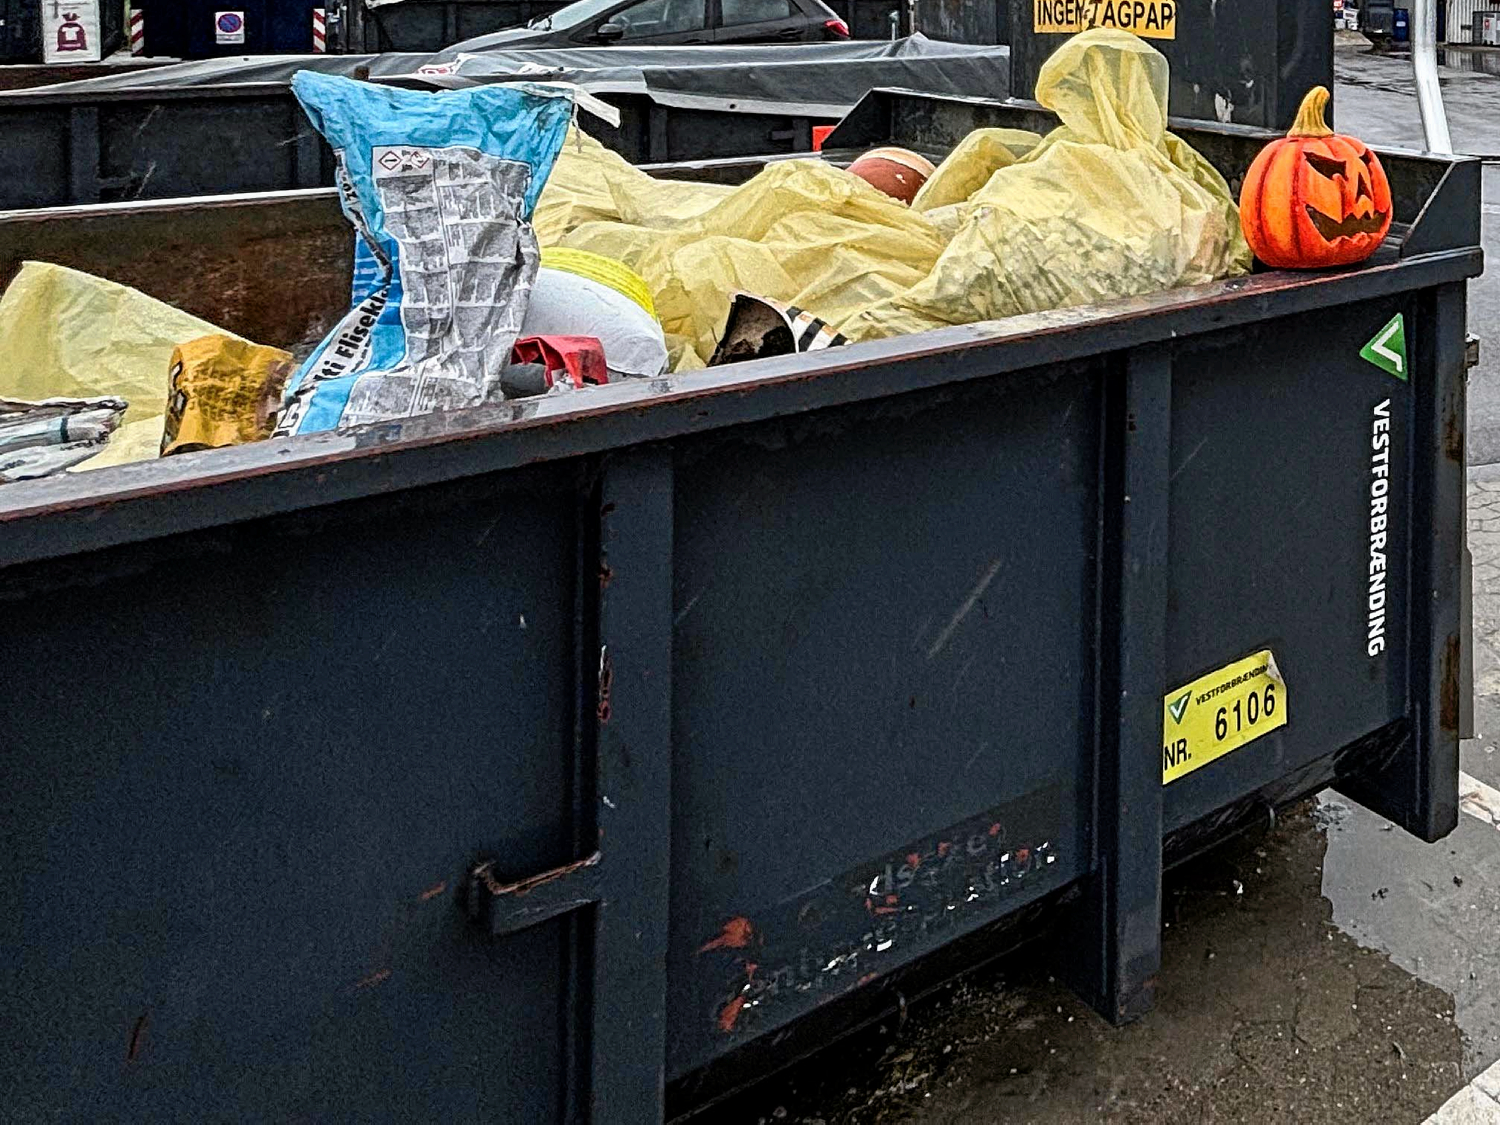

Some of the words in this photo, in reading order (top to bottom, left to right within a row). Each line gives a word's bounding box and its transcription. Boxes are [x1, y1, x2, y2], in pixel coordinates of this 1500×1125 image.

[1091, 0, 1174, 30] TAGPAP
[1367, 398, 1391, 657] VESTFORBRÆNDING
[1196, 664, 1269, 706] VESTFORBRÆNDIN
[1164, 737, 1192, 771] NR.
[1215, 683, 1276, 742] 6106
